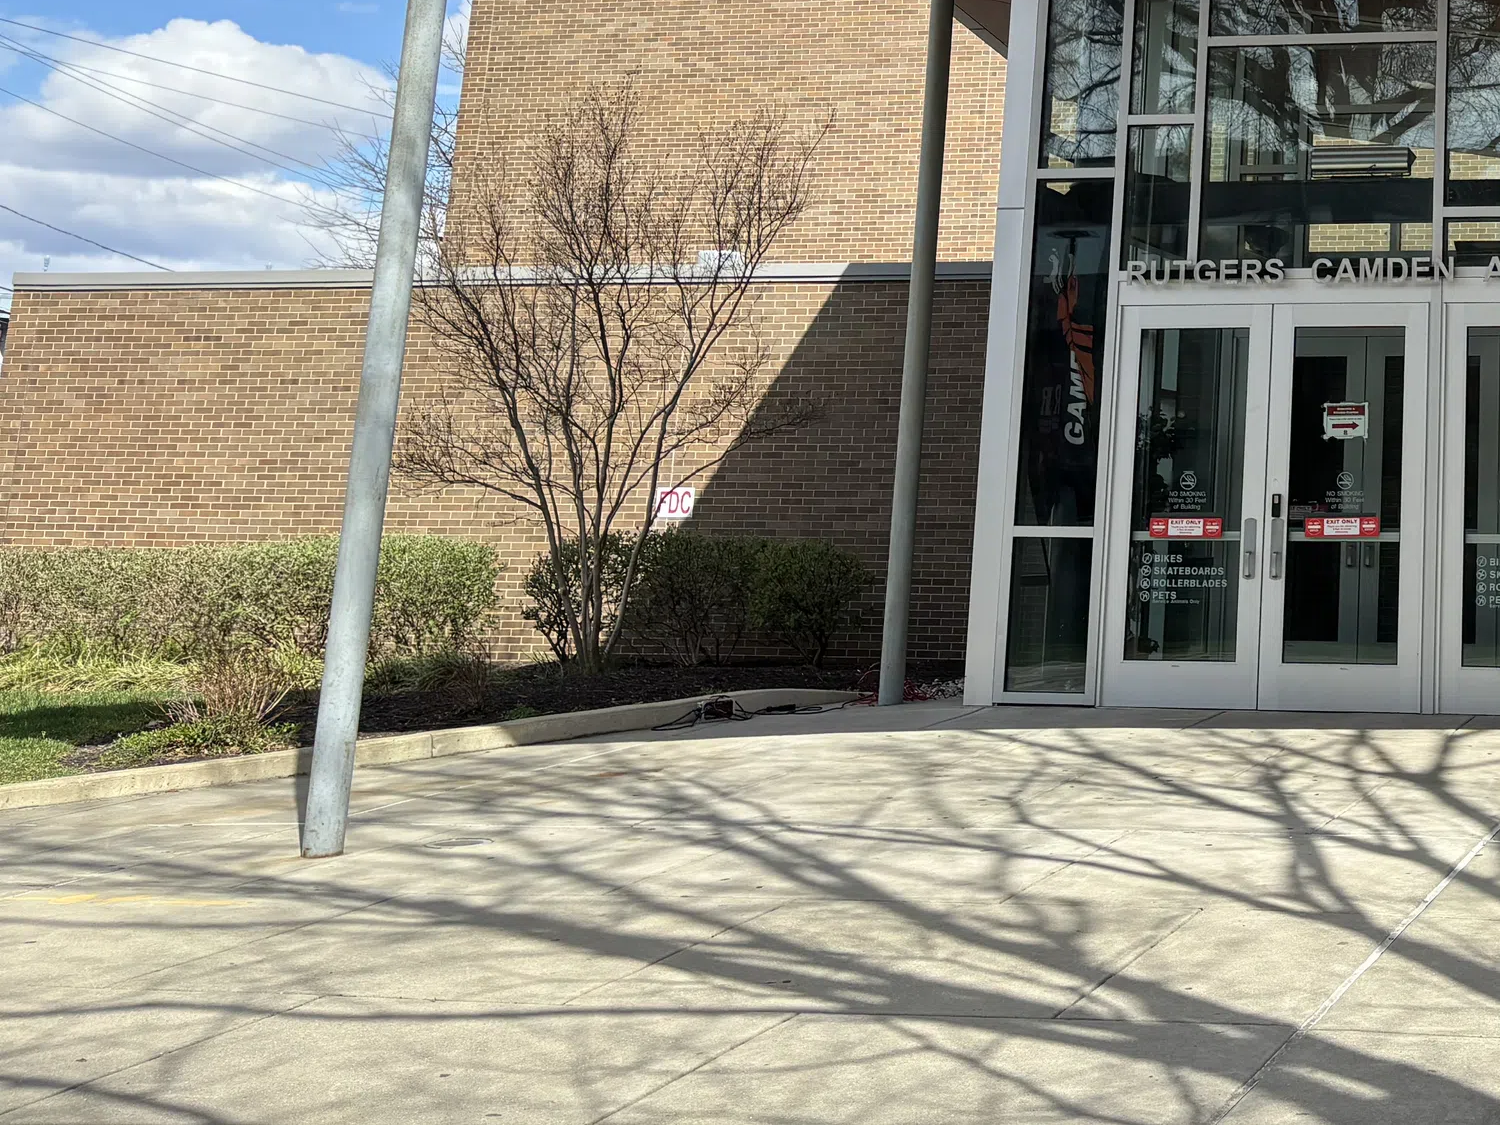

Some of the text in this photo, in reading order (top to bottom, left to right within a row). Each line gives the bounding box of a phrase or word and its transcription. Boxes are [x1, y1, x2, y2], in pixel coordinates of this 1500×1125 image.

[1126, 258, 1285, 285] RUTGERS
[1311, 256, 1455, 284] CAMDEN
[658, 491, 691, 514] FDC
[1154, 555, 1183, 563] BIKES
[1154, 567, 1224, 575] SKATEBOARDS
[1153, 579, 1227, 588] ROLLERBLADES
[1152, 591, 1177, 600] PETS
